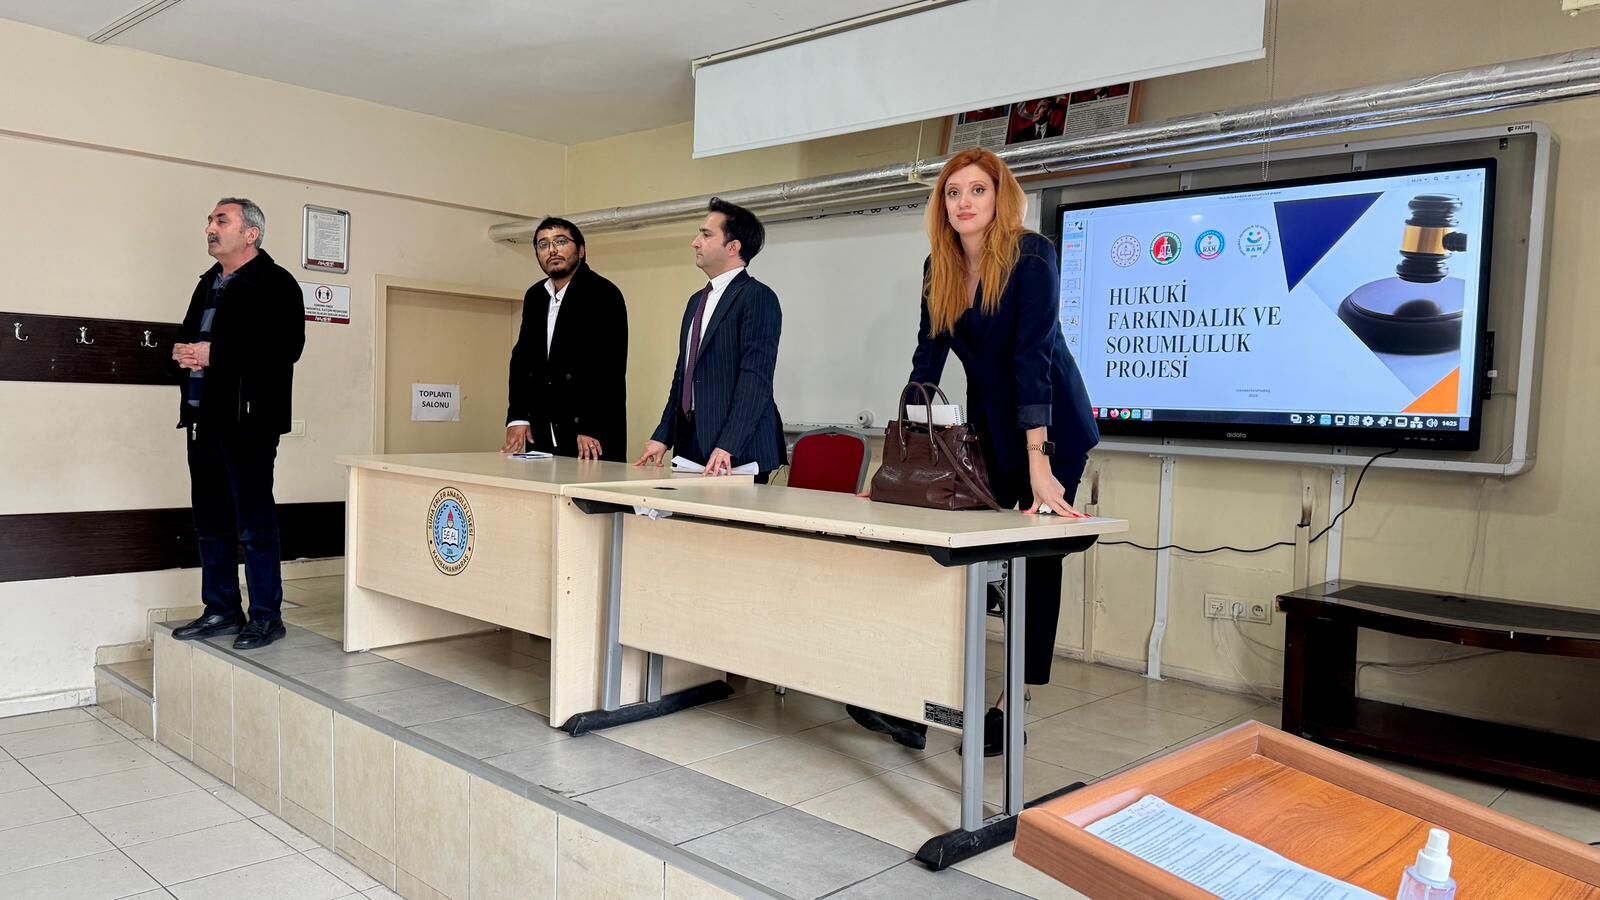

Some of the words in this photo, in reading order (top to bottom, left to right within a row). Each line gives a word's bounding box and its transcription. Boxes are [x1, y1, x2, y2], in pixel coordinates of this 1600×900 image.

[1109, 279, 1188, 306] HUKUKİ
[1107, 307, 1247, 330] FARKINDALIK
[1253, 306, 1282, 327] VE
[1106, 333, 1252, 354] SORUMLULUK
[1105, 355, 1189, 379] PROJESİ
[419, 390, 452, 399] TOPLANTI
[421, 400, 450, 409] SALONU
[446, 490, 468, 511] ANADOLU
